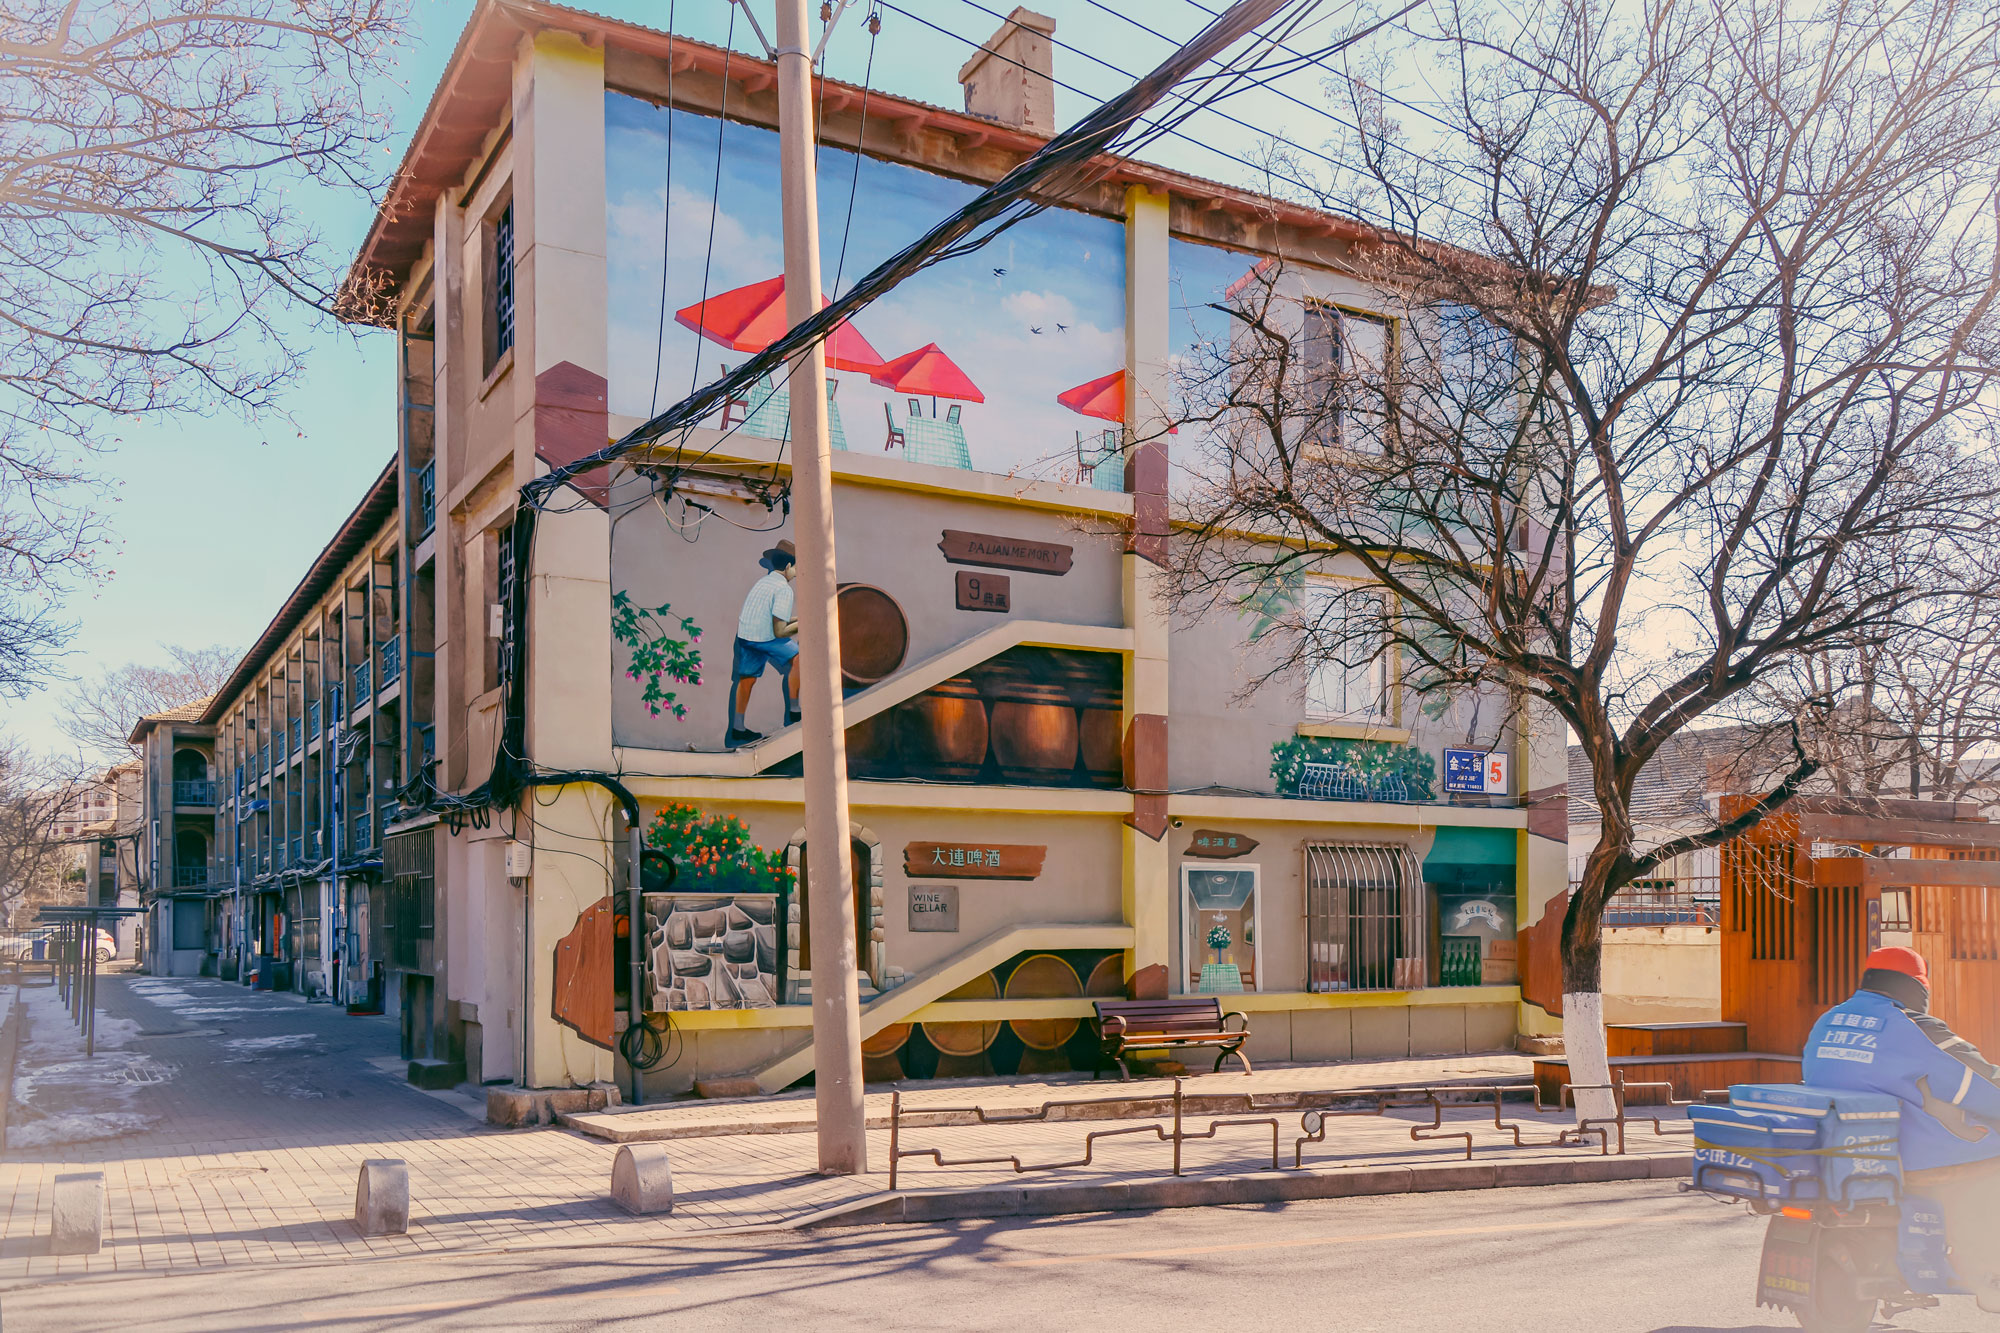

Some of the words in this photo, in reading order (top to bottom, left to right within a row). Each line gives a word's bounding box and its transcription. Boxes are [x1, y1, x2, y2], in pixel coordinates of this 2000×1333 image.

[968, 541, 1010, 557] DALIAN
[1010, 546, 1060, 564] MEMORY
[968, 578, 981, 601] 9
[1490, 761, 1503, 784] 5
[1197, 836, 1238, 849] 啤酒屋
[931, 847, 1001, 868] 大連啤酒
[912, 903, 948, 913] CELLAR
[913, 893, 940, 903] WINE
